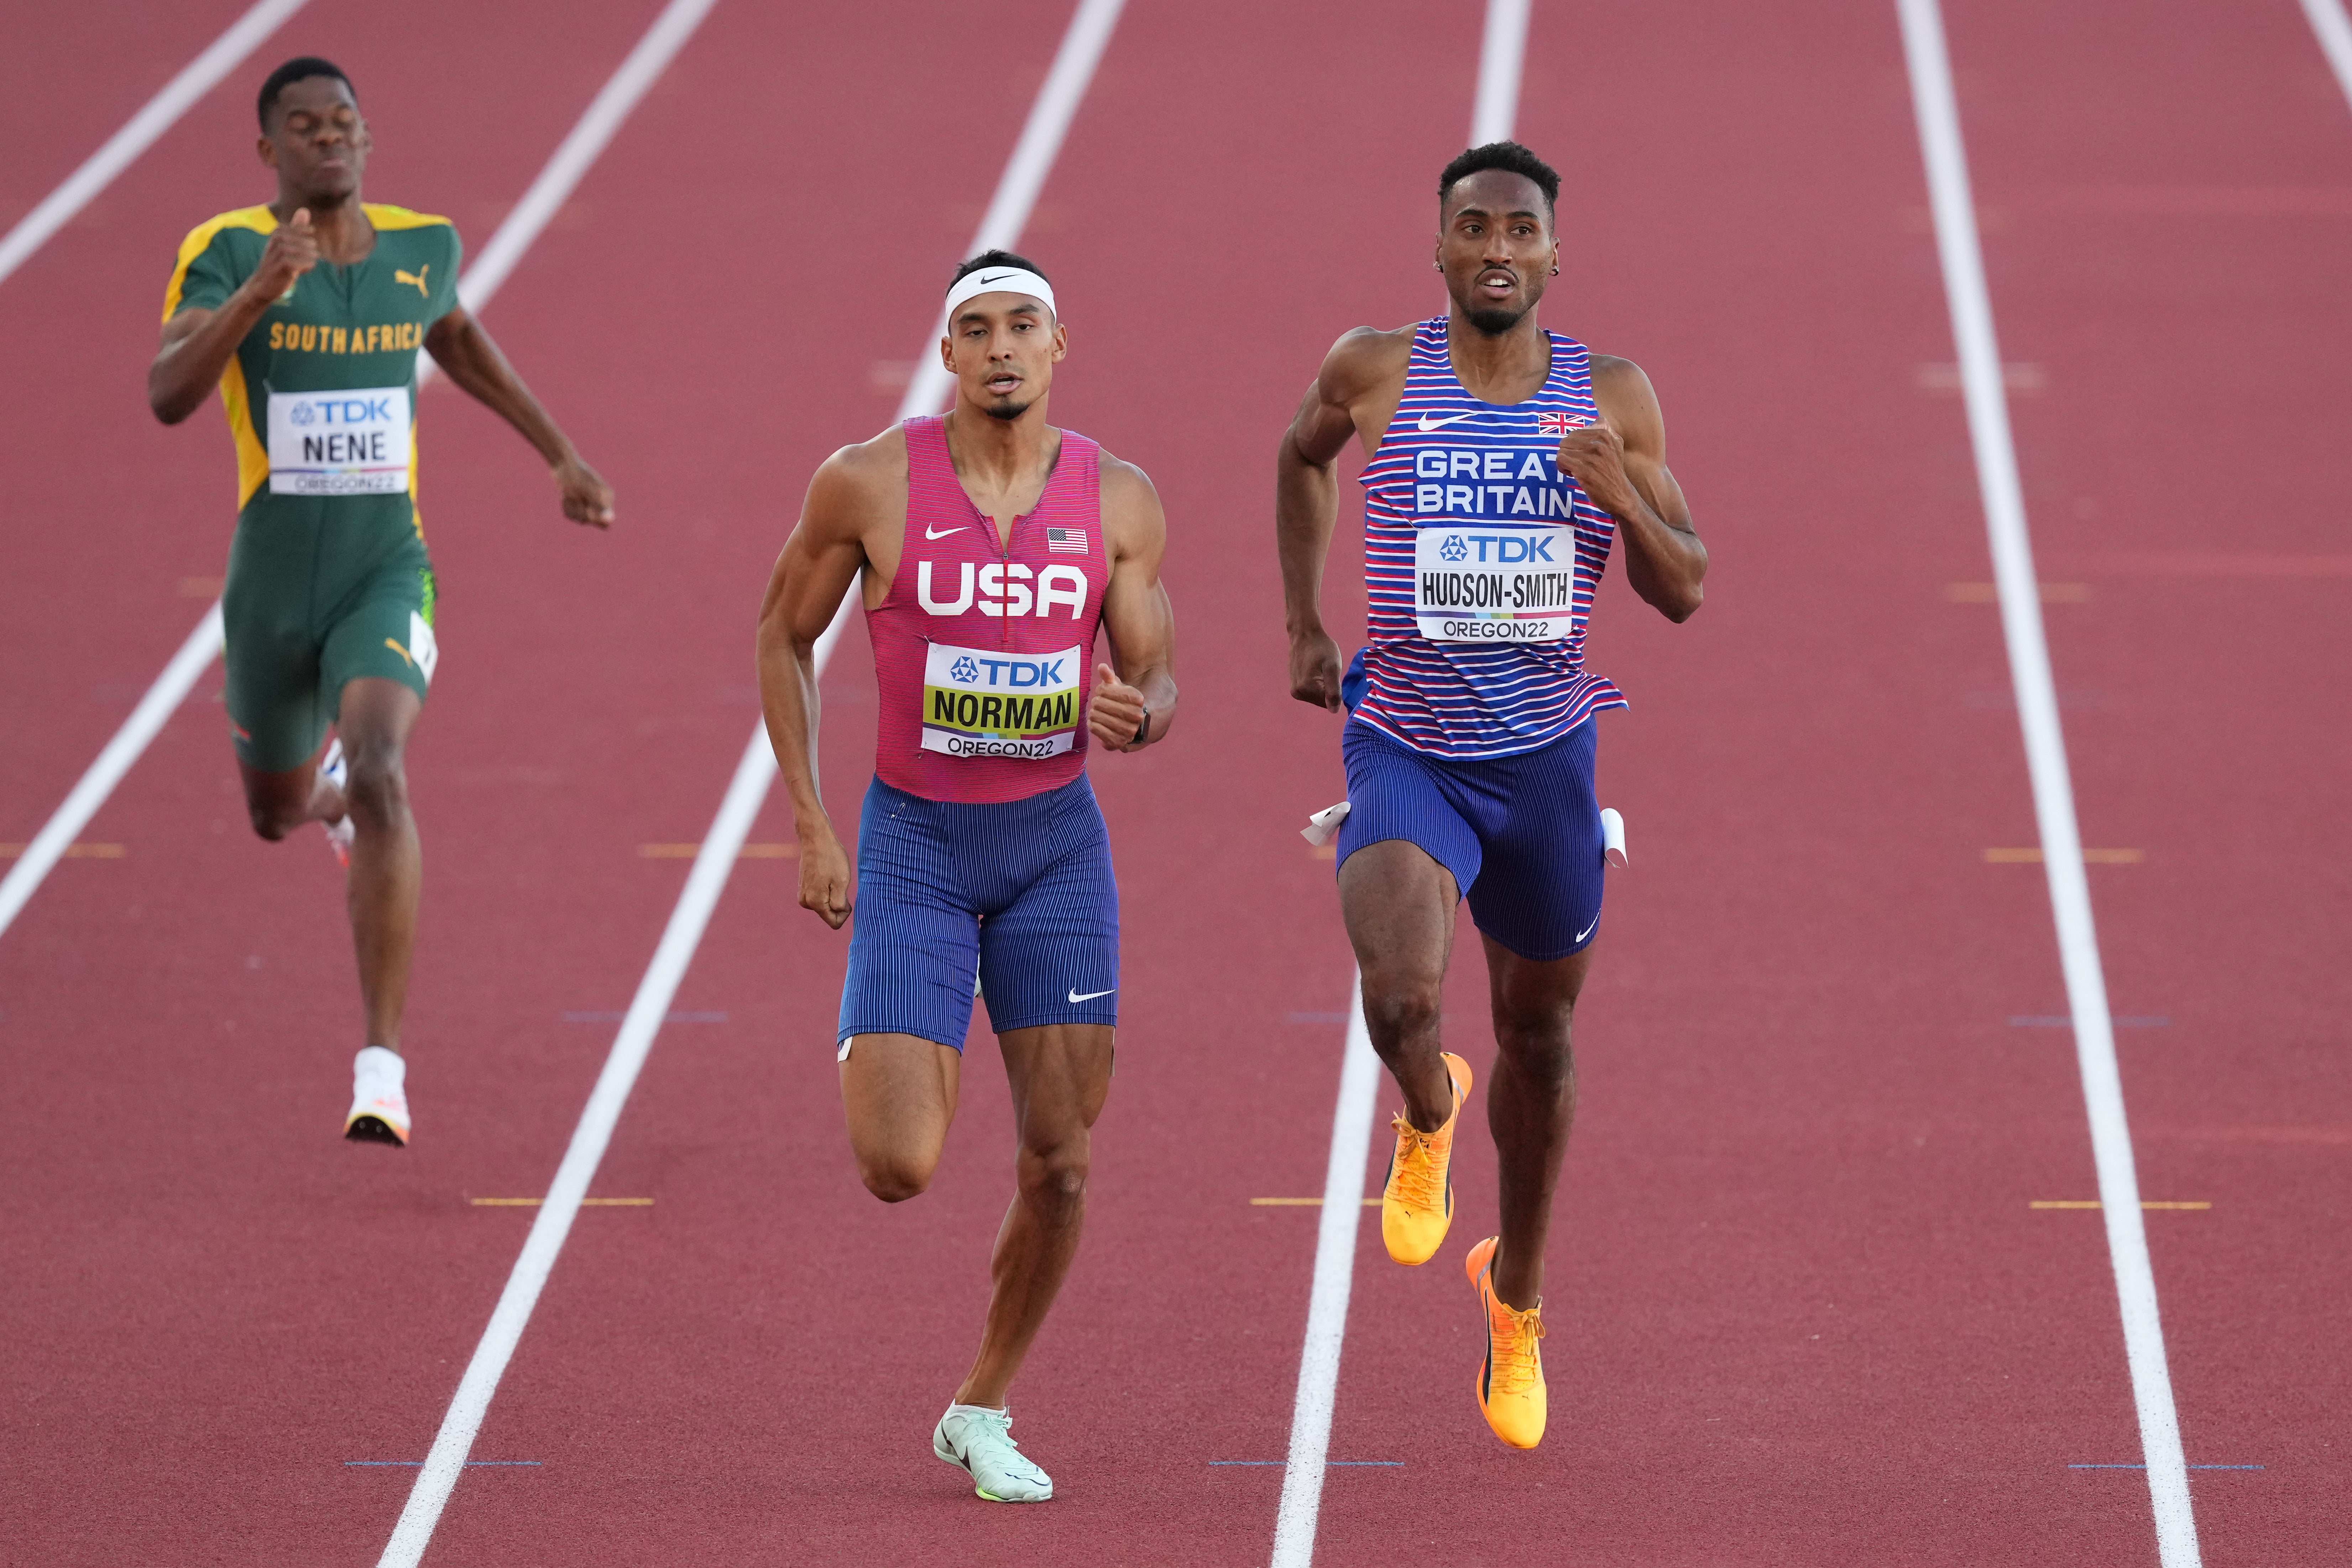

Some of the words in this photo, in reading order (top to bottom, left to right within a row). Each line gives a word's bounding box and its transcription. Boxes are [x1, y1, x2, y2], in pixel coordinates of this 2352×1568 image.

[269, 322, 346, 354] SOUTH
[317, 398, 391, 423] TDK
[304, 432, 385, 462] NENE
[1417, 484, 1572, 518] BRITAIN
[1468, 536, 1554, 562] TDK
[918, 561, 1088, 620] USA
[1423, 573, 1568, 607] HUDSON-SMITH
[1444, 621, 1548, 637] OREGON22
[979, 658, 1064, 686] TDK
[934, 690, 1071, 729] NORMAN
[947, 737, 1053, 757] OREGON22
